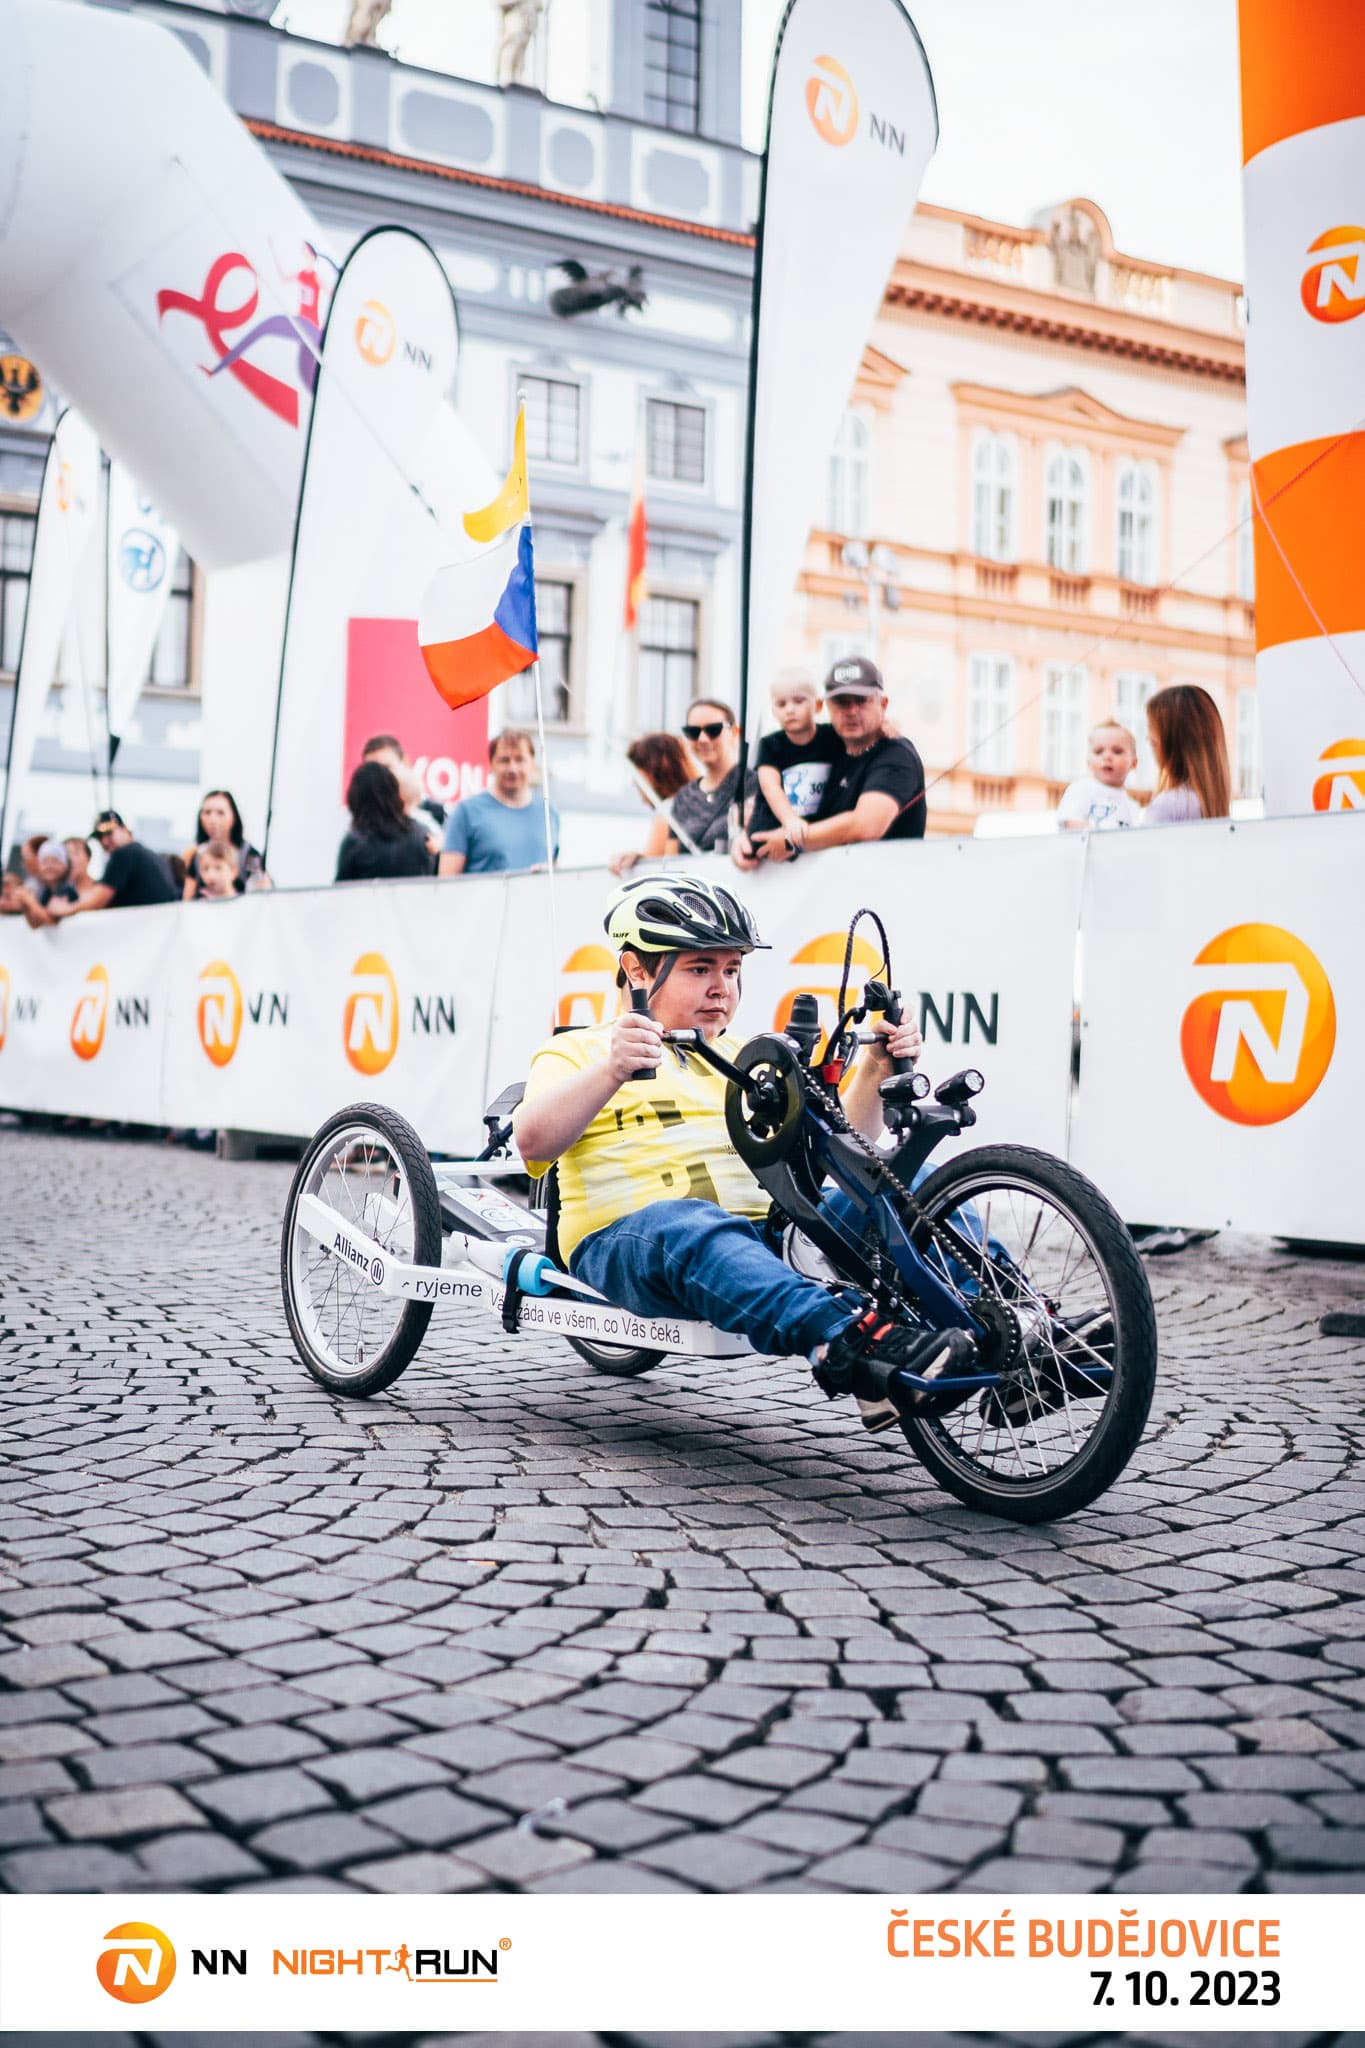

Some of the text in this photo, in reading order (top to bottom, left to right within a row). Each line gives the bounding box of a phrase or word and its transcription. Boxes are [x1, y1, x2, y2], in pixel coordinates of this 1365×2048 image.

[869, 111, 905, 156] NN
[115, 995, 150, 1026] NN
[412, 993, 456, 1034] NN
[918, 991, 999, 1045] NN
[333, 1232, 370, 1272] Allianz
[548, 1310, 561, 1325] ve
[565, 1311, 600, 1333] všem,
[604, 1317, 619, 1334] co
[622, 1317, 646, 1338] Vás
[650, 1322, 684, 1345] čeká.
